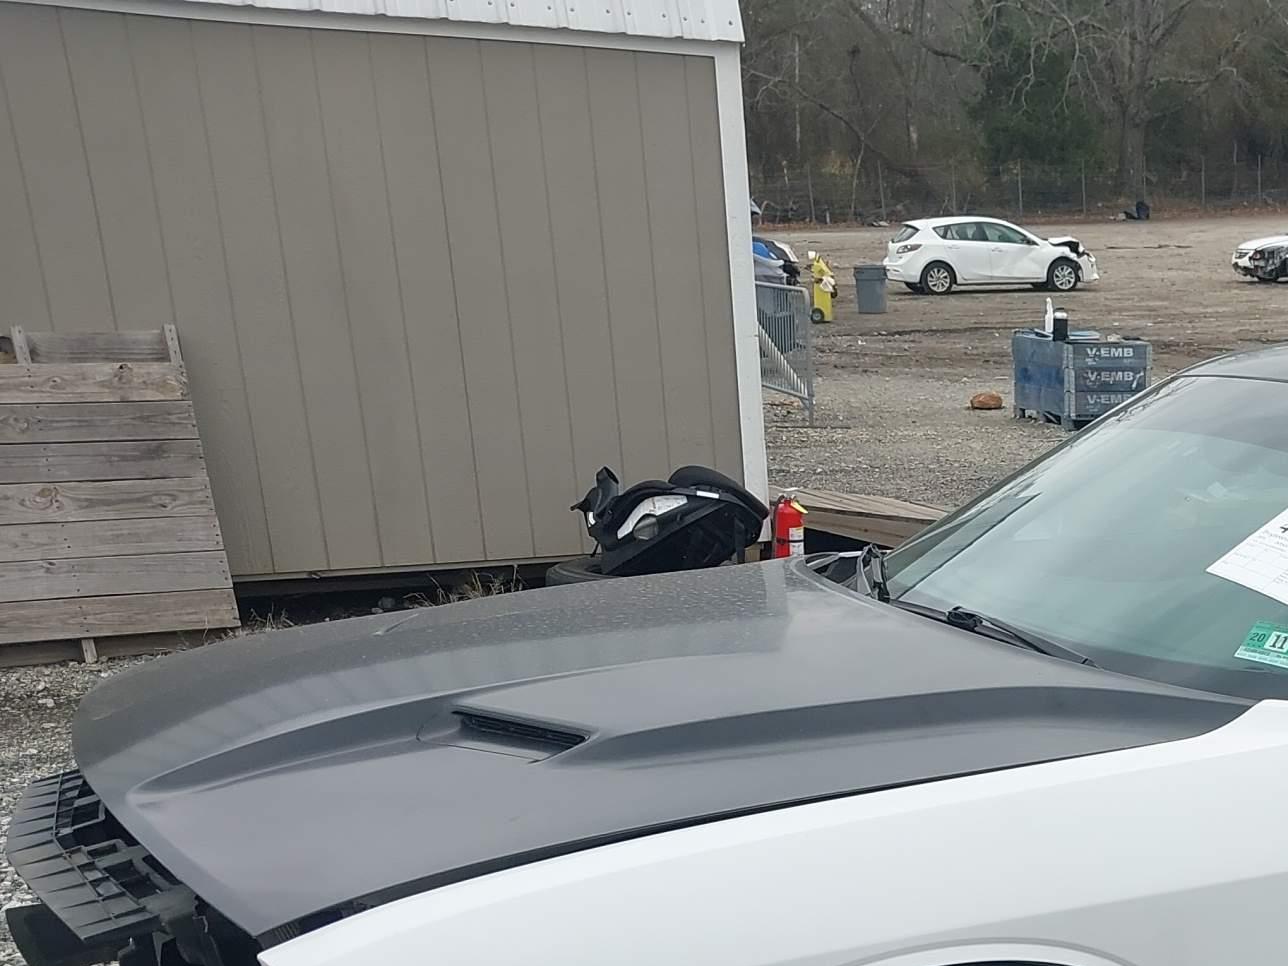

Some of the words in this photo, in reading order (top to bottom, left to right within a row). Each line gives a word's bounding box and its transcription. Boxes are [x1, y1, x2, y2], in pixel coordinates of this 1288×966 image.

[1087, 347, 1134, 358] V-EMB
[1087, 371, 1134, 381] V-EMB
[1249, 632, 1266, 643] 20
[1269, 633, 1288, 650] 11
